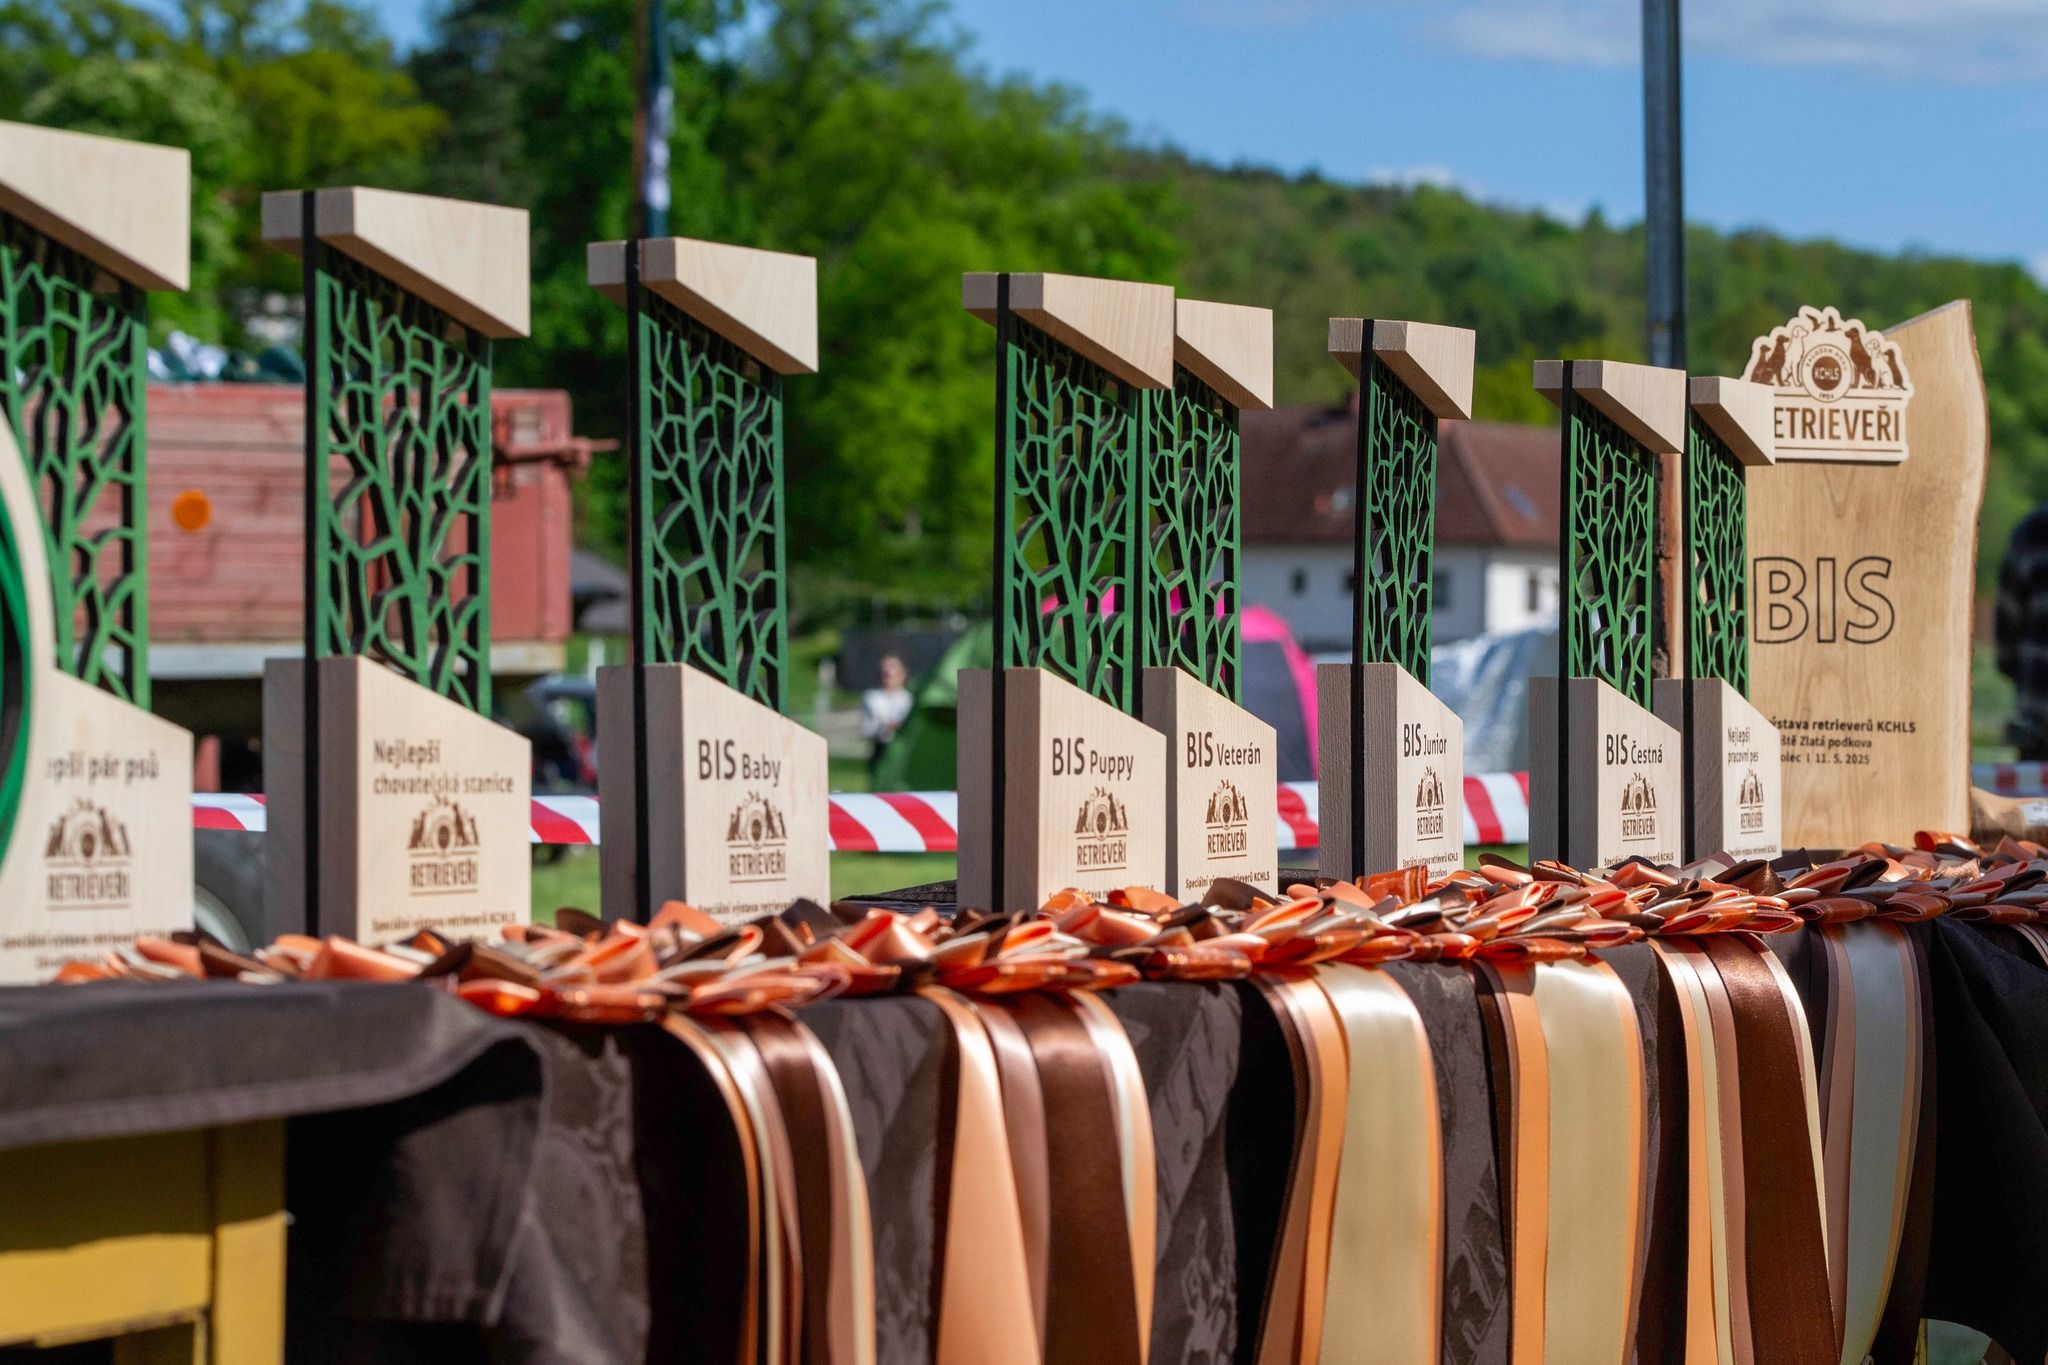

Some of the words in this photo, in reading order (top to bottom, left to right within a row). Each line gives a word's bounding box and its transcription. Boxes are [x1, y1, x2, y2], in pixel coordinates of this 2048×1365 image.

[1814, 367, 1840, 381] KCHLS
[1774, 405, 1900, 442] ETRIEVEŘI
[1753, 556, 1895, 645] BIS
[1728, 726, 1751, 747] Nejlepší
[1769, 716, 1809, 730] ýstava
[1812, 719, 1873, 732] retrieverů
[1877, 721, 1916, 734] KCHLS
[1187, 731, 1213, 768] BIS
[1217, 742, 1261, 766] Veterán
[1404, 723, 1421, 757] BIS
[1424, 733, 1447, 755] Junior
[1606, 734, 1628, 765] BIS
[1631, 740, 1663, 764] Čestná
[1780, 734, 1797, 747] ště
[1800, 735, 1825, 748] Zlatá
[1828, 737, 1872, 750] podkova
[374, 740, 440, 770] Nejlepší
[699, 739, 736, 780] BIS
[742, 753, 781, 787] Baby
[1052, 737, 1085, 776] BIS
[1090, 750, 1134, 781] Puppy
[1780, 752, 1801, 763] olec
[1833, 753, 1843, 764] 5.
[1845, 753, 1870, 765] 2025
[374, 772, 459, 795] chovatelská
[463, 771, 514, 794] stanice
[1417, 814, 1443, 836] RETRIEVEŘI
[1623, 815, 1655, 837] RETRIEVEŘI
[1077, 840, 1126, 866] RETRIEVEŘI
[1208, 829, 1247, 854] RETRIEVEŘI
[410, 858, 478, 888] RETRIEVEŘI
[729, 850, 786, 876] RETRIEVEŘI
